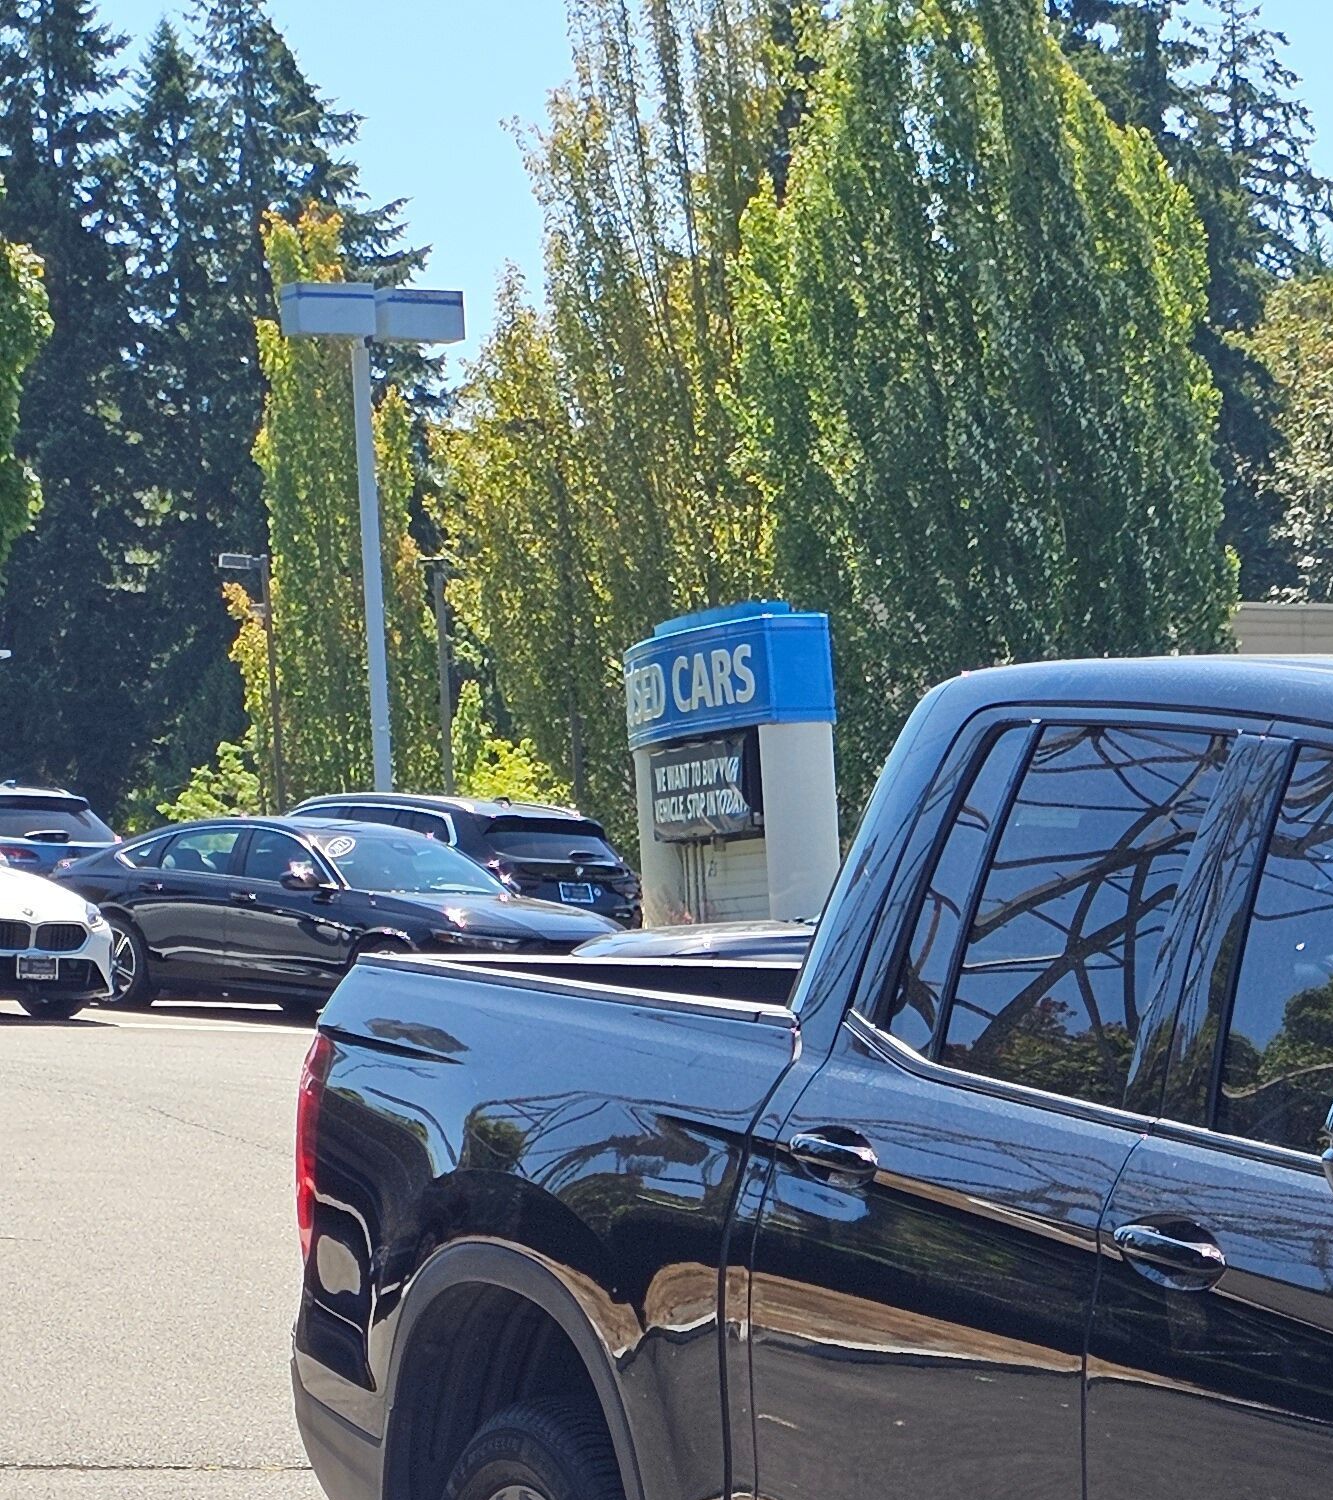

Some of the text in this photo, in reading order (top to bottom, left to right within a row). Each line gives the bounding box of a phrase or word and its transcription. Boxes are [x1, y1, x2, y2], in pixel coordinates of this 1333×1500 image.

[672, 644, 756, 713] CARS
[667, 762, 690, 791] WANT
[691, 761, 701, 787] TO
[702, 758, 718, 786] BUY
